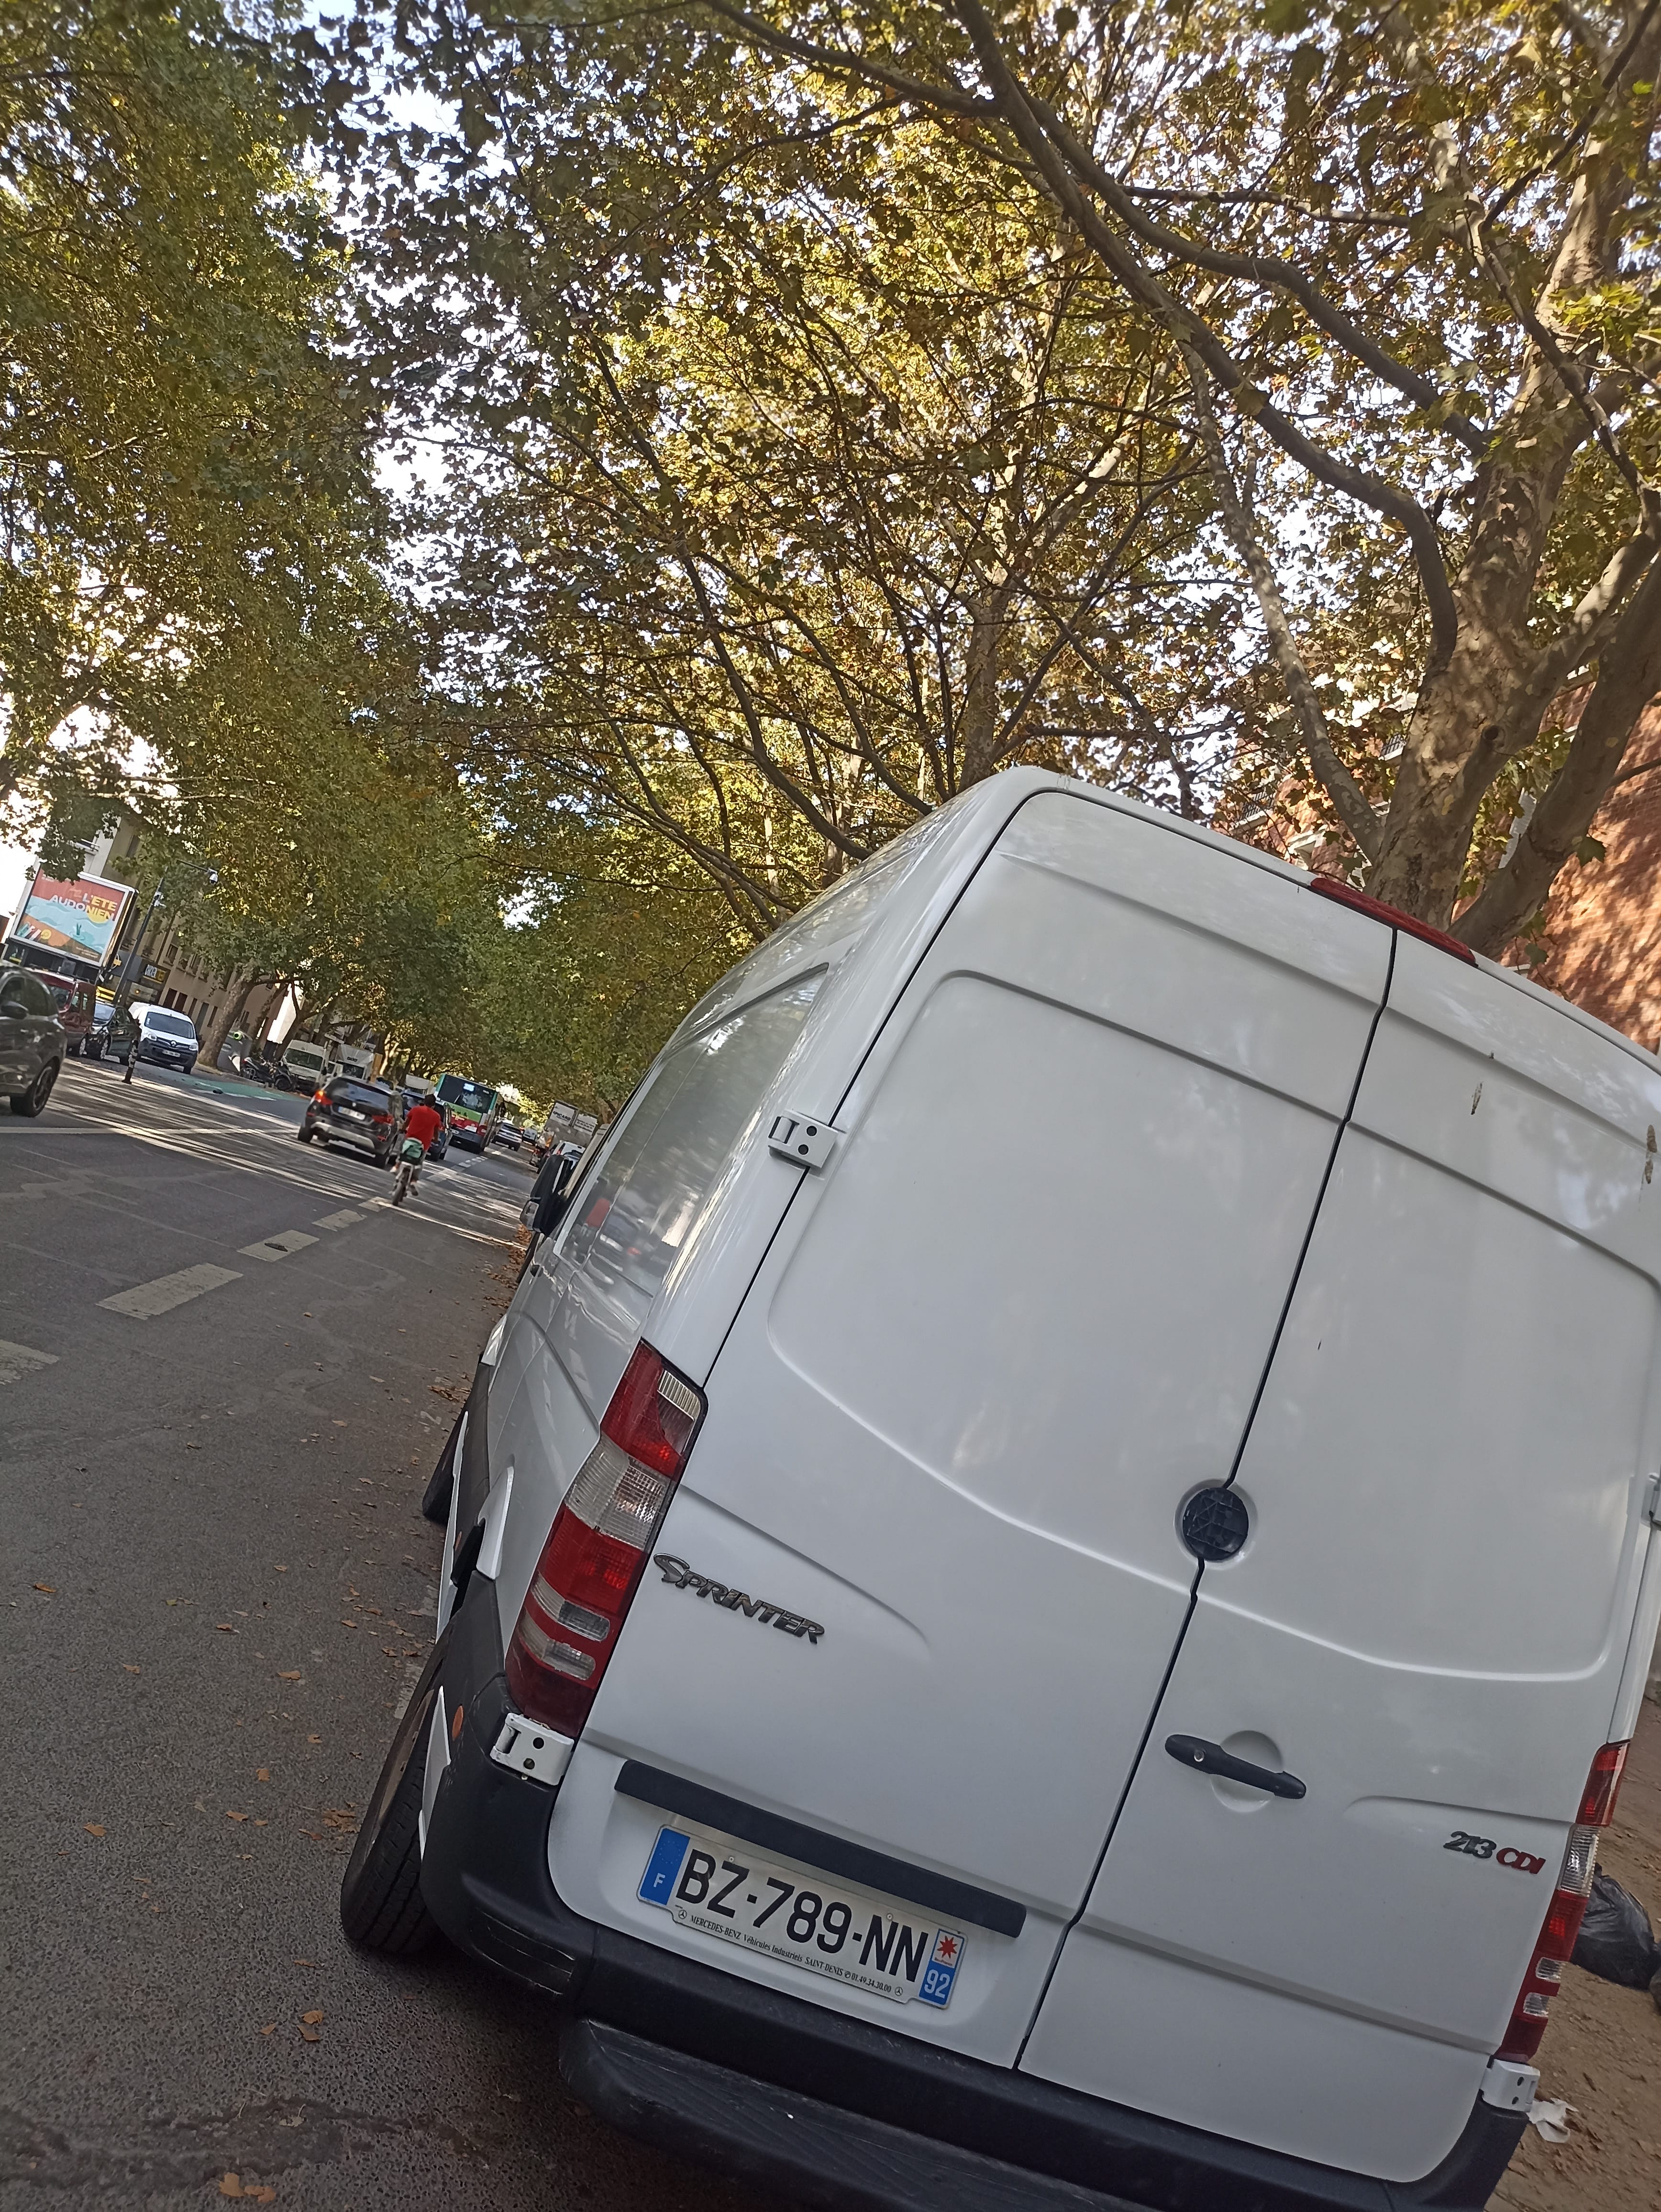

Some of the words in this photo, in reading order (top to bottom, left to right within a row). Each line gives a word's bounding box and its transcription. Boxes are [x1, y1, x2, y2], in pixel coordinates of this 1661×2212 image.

[51, 895, 115, 921] AUDONIEN
[653, 1553, 825, 1644] SPRINTER
[1443, 1831, 1497, 1858] 213
[1496, 1847, 1546, 1874] CDI
[653, 1873, 665, 1887] F
[675, 1849, 929, 1982] BZ-789-NN
[690, 1915, 741, 1940] MERCEDES-BENZ
[744, 1934, 771, 1950] Véhicules
[772, 1945, 803, 1962] Industriels
[805, 1957, 843, 1976] SAINT-DENIS
[924, 1969, 951, 1999] 92
